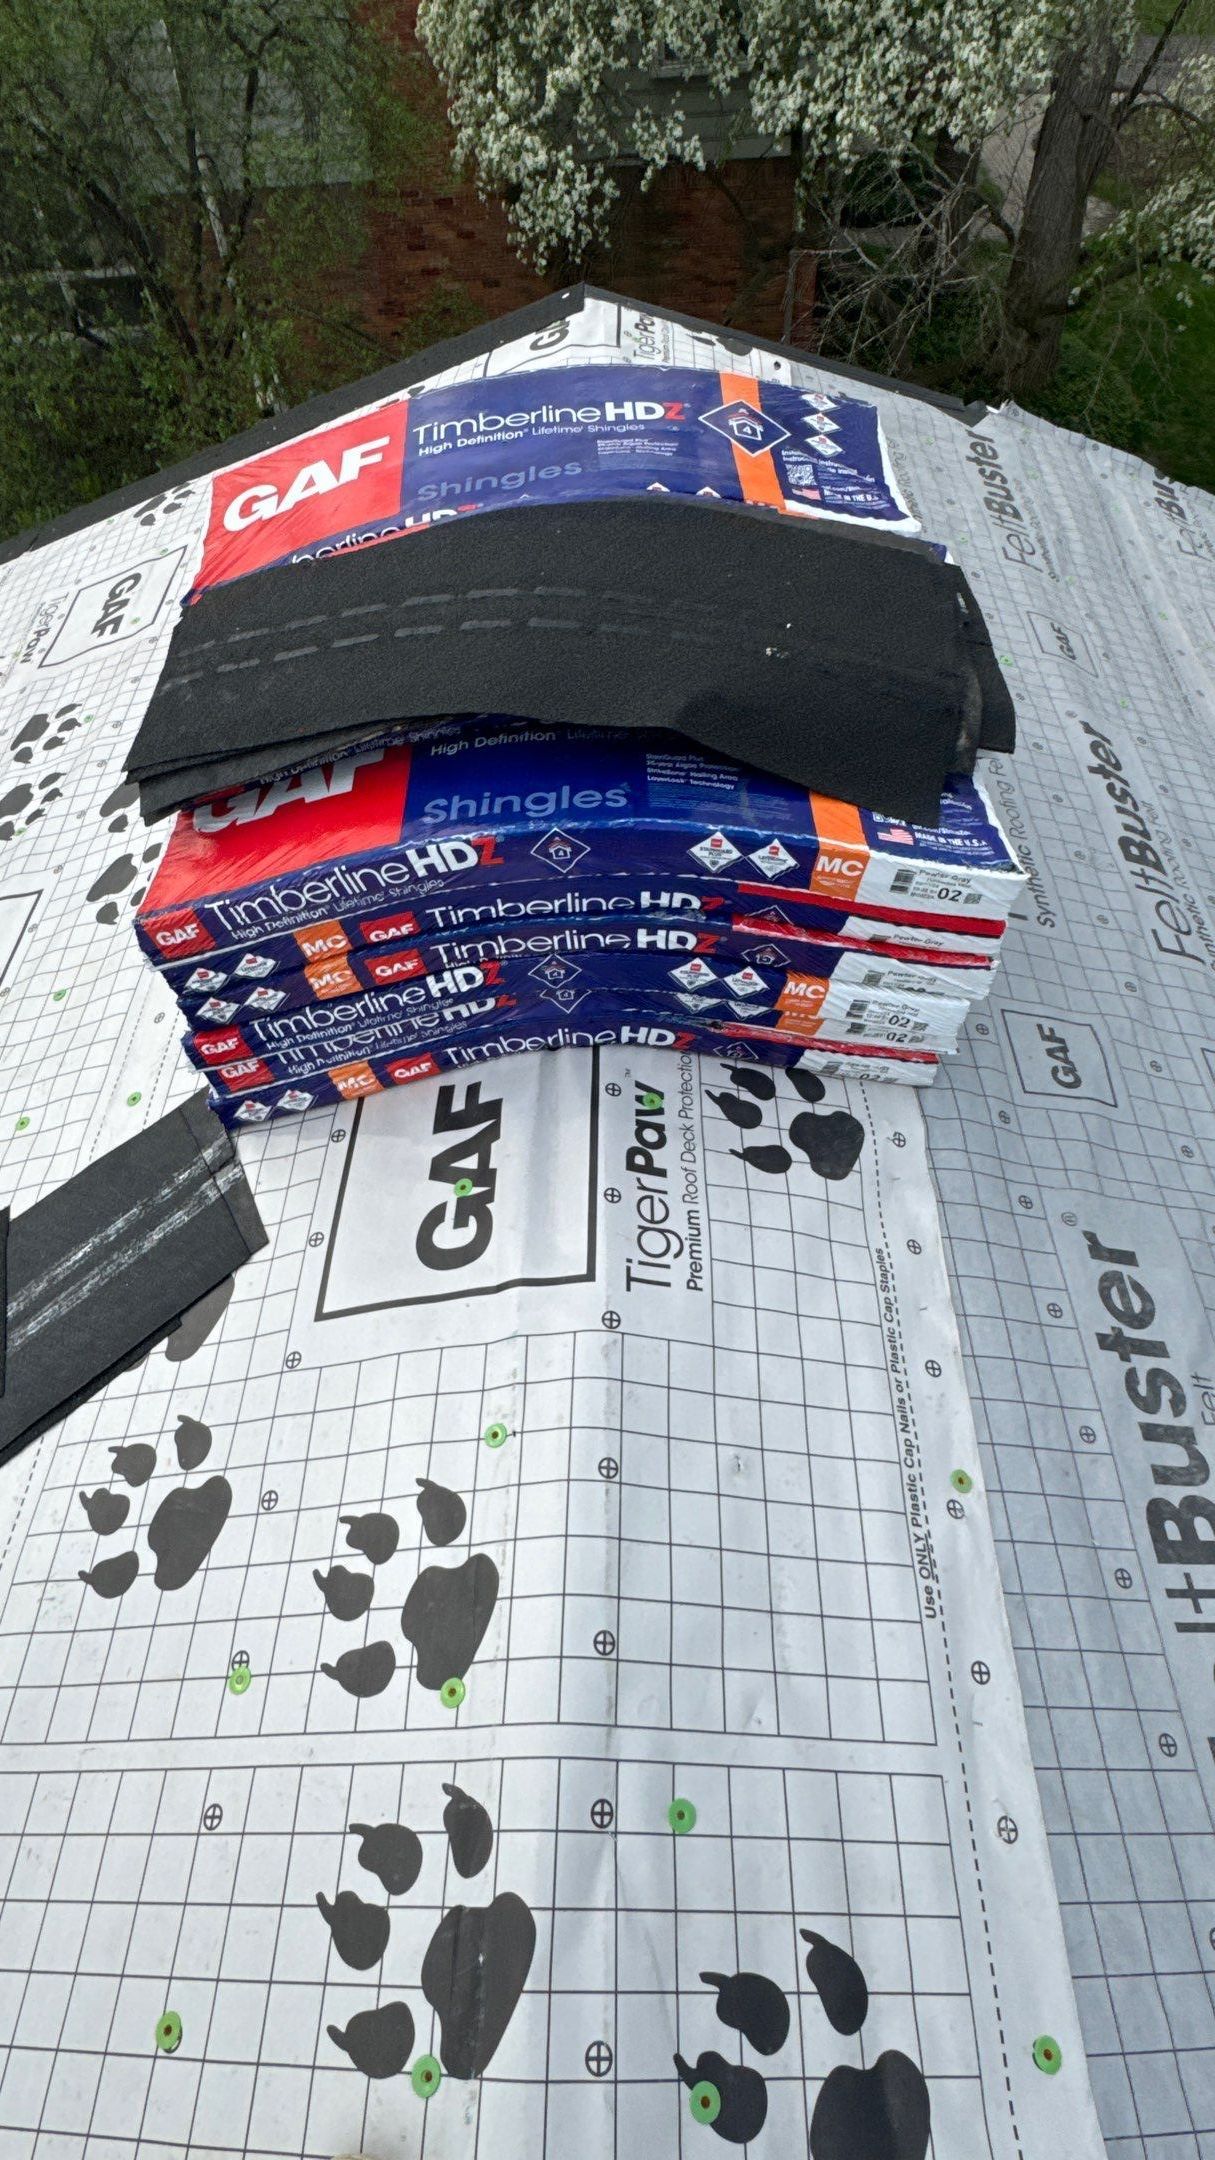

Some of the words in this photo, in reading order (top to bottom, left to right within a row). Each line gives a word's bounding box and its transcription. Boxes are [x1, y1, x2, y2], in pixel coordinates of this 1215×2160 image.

[418, 441, 453, 457] High
[457, 429, 523, 446] Definition
[587, 423, 645, 434] Shingles
[223, 436, 390, 532] GAF
[417, 461, 583, 501] Shingles
[966, 429, 1044, 573] FeltBuster
[91, 572, 142, 638] GAF
[20, 592, 69, 664] TigerPaw
[1050, 622, 1076, 661] GAF
[431, 739, 469, 756] High
[475, 730, 556, 748] Definition
[193, 750, 385, 833] GAF
[423, 785, 629, 825] Shingles
[1079, 719, 1206, 966] FeltBuster
[816, 856, 864, 877] MC
[937, 887, 962, 901] 02
[155, 923, 202, 948] GAF
[231, 924, 264, 941] High
[265, 905, 327, 931] Definition
[369, 923, 415, 943] GAF
[302, 934, 348, 957] MC
[308, 969, 354, 990] MC
[375, 958, 419, 977] GAF
[784, 981, 826, 999] MC
[888, 1015, 911, 1029] 02
[200, 1037, 239, 1056] GAF
[1036, 1023, 1082, 1089] GAF
[222, 1060, 260, 1079] GAF
[394, 1063, 432, 1078] GAF
[680, 1123, 697, 1164] Deck
[415, 1081, 503, 1271] GAF
[625, 1080, 684, 1292] TigerPaw
[682, 1166, 699, 1205] Roof
[686, 1209, 703, 1292] Premium
[876, 1247, 891, 1294] Staples
[884, 1296, 895, 1323] Cap
[888, 1326, 902, 1374] Plastic
[895, 1378, 905, 1393] or
[900, 1398, 911, 1434] Nails
[903, 1438, 916, 1469] Cap
[907, 1475, 924, 1528] Plastic
[913, 1535, 931, 1580] ONLY
[923, 1585, 937, 1619] Use
